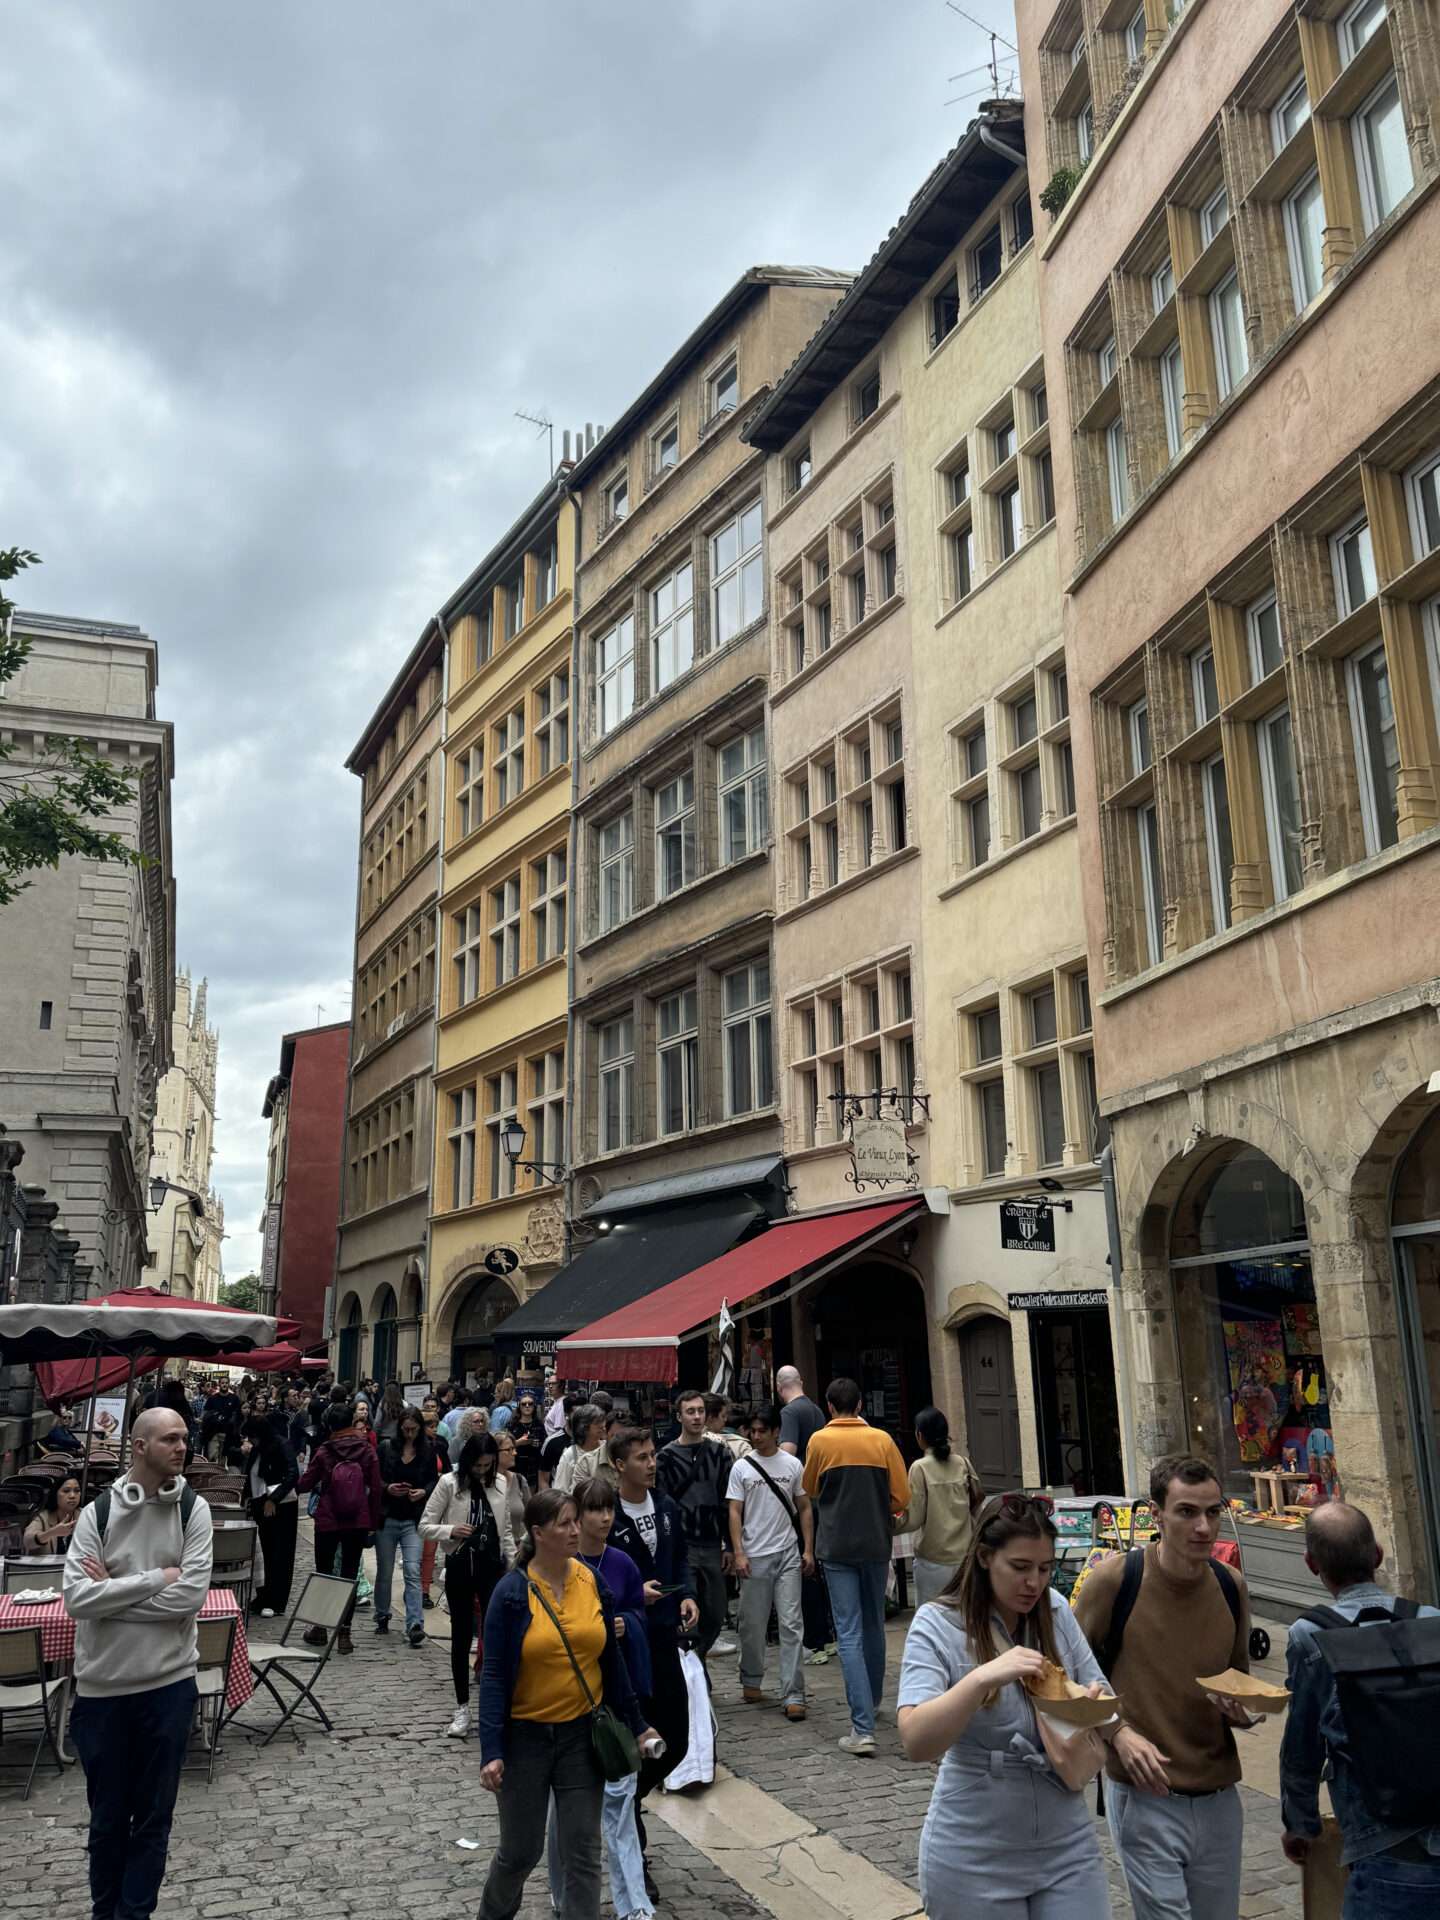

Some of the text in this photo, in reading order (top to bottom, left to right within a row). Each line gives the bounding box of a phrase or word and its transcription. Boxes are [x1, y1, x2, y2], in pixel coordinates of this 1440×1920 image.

[857, 1147, 906, 1164] Le Vieux Lyon
[980, 1356, 993, 1368] 44
[623, 1534, 630, 1544] 9
